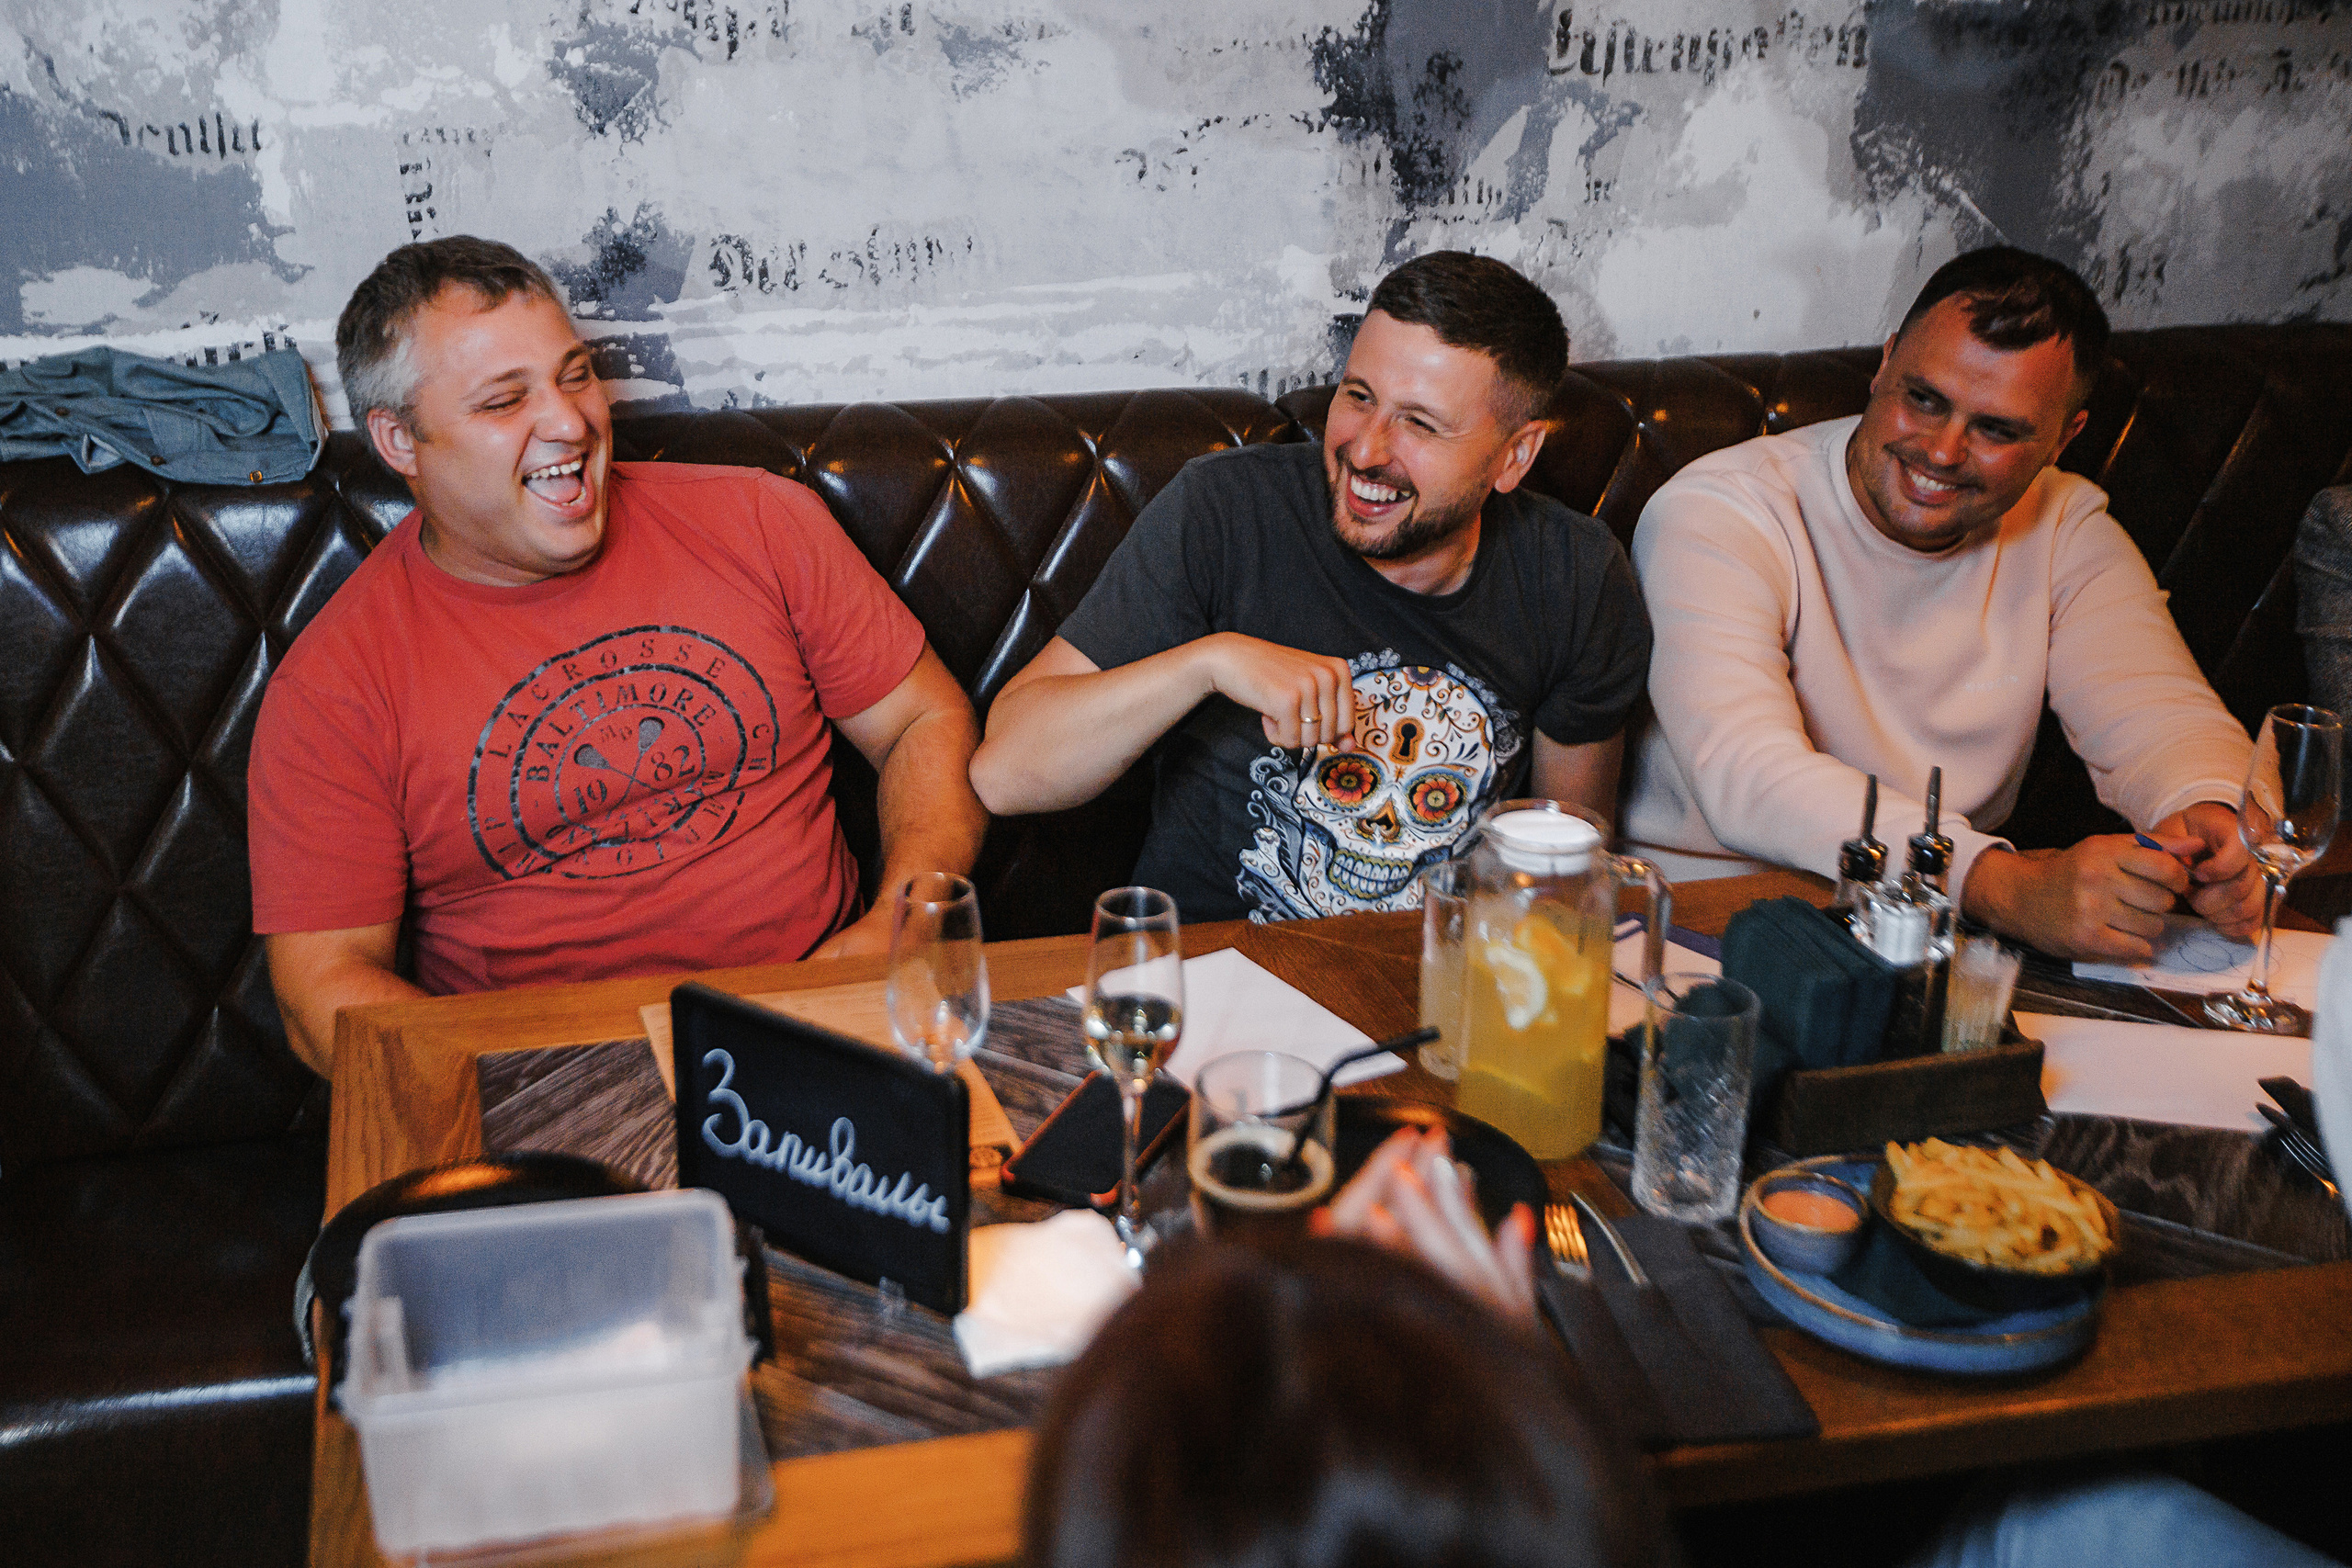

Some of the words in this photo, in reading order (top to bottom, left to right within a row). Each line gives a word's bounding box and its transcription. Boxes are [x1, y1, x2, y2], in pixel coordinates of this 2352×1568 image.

[488, 637, 727, 761] LACROSSE
[526, 682, 718, 783] BALTIMORE
[650, 745, 696, 783] 82
